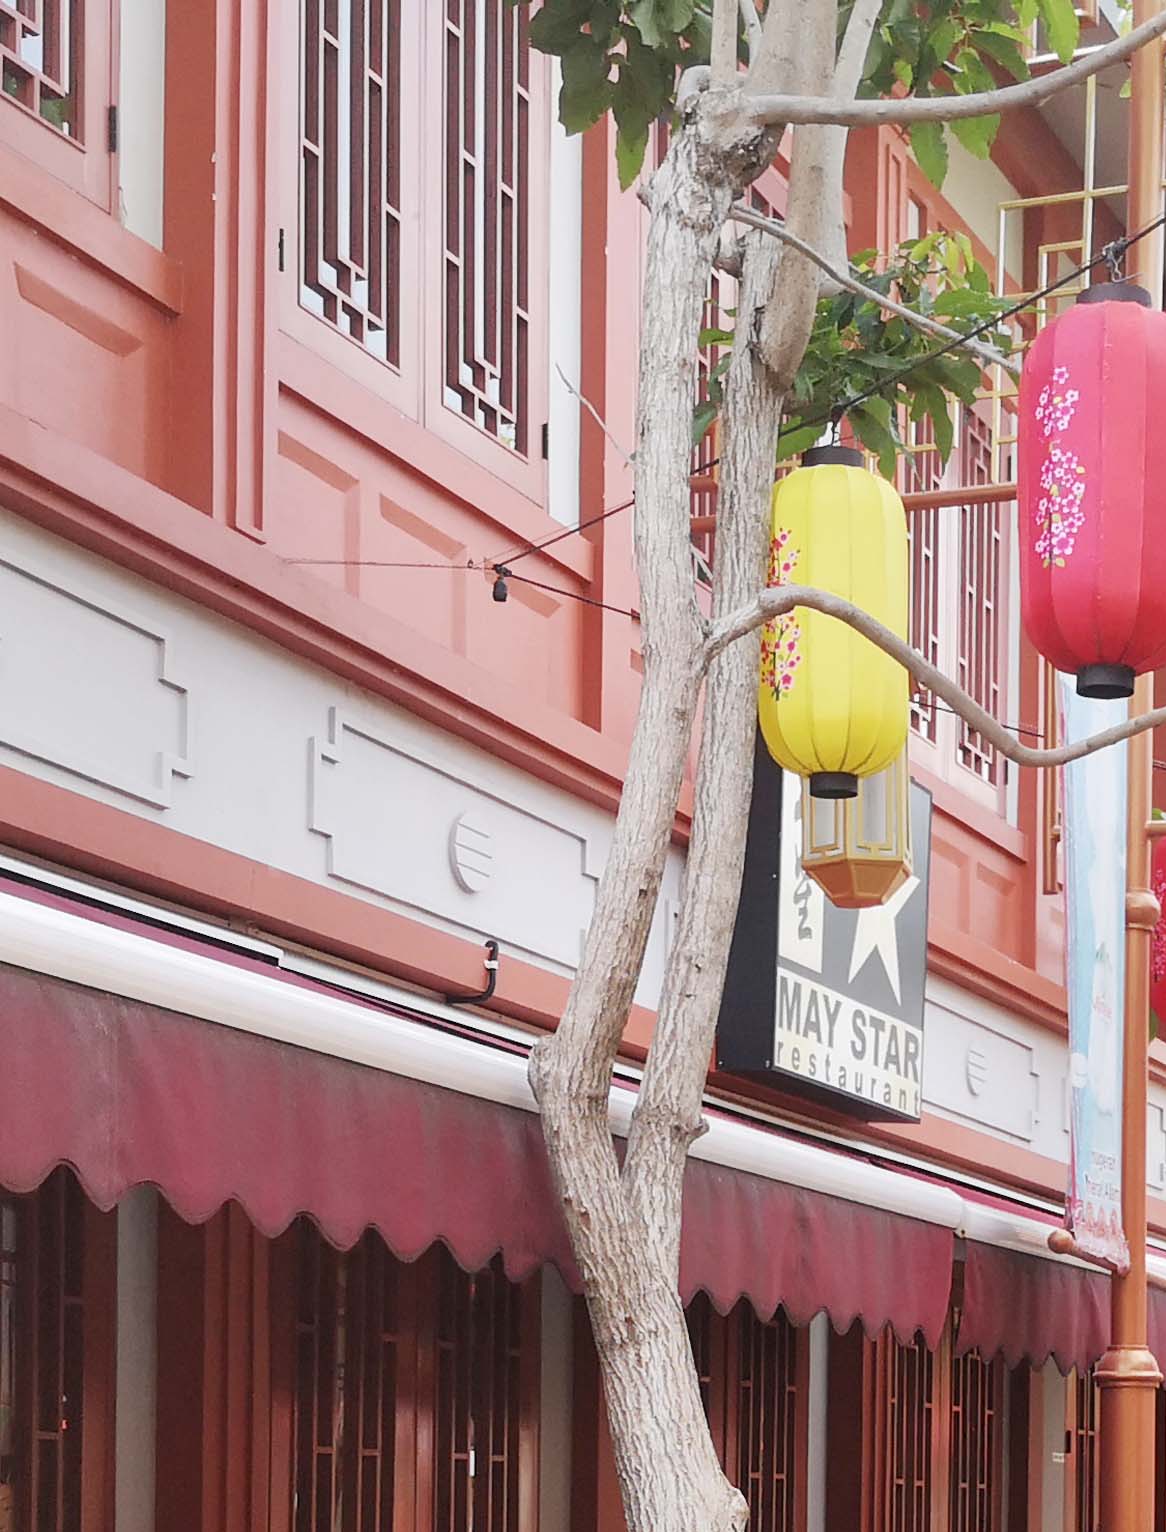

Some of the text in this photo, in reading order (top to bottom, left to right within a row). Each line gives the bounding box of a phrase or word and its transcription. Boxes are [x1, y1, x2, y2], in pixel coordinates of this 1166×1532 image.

[778, 976, 920, 1084] MAY STAR
[775, 1039, 920, 1116] restaurant
